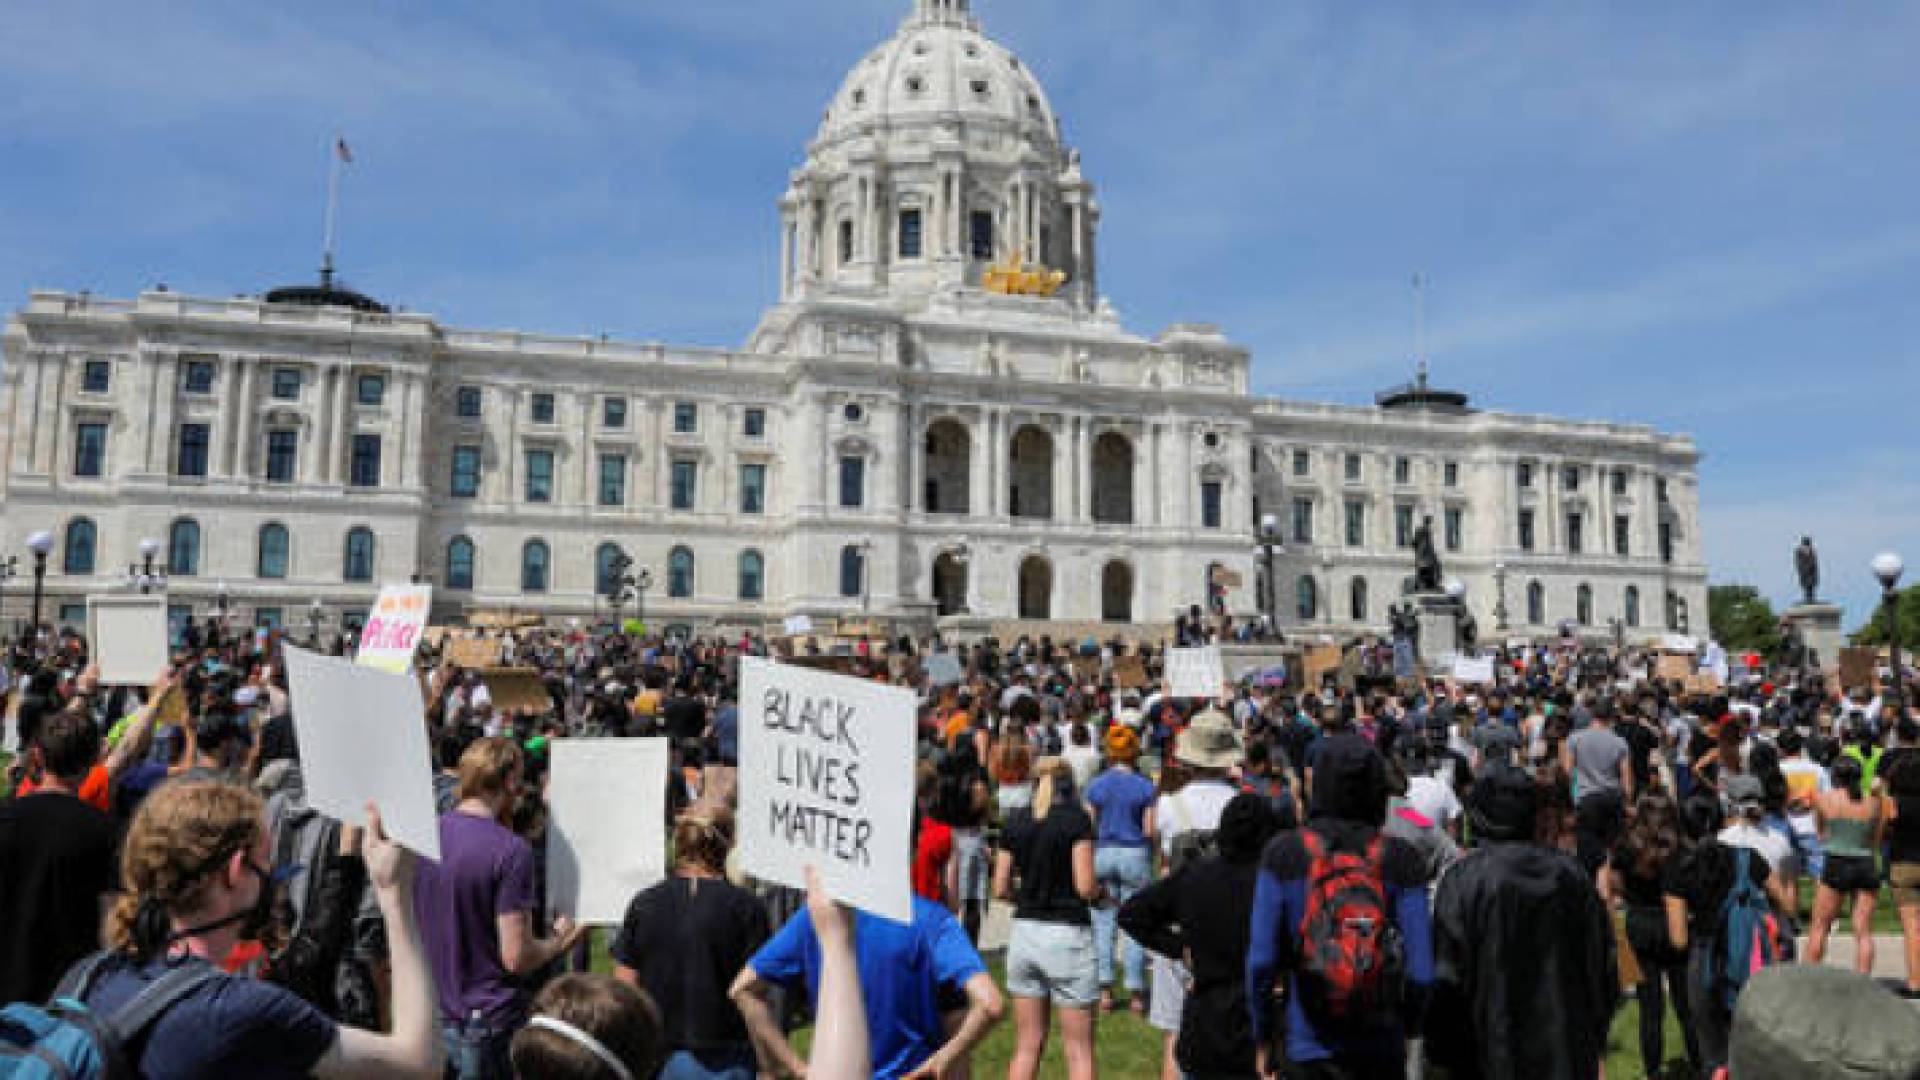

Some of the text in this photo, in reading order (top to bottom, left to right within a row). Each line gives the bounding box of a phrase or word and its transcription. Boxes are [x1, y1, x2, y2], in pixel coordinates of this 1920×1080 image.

[764, 688, 859, 754] BLACK
[778, 744, 860, 805] LIVES
[770, 799, 872, 867] MATTER
